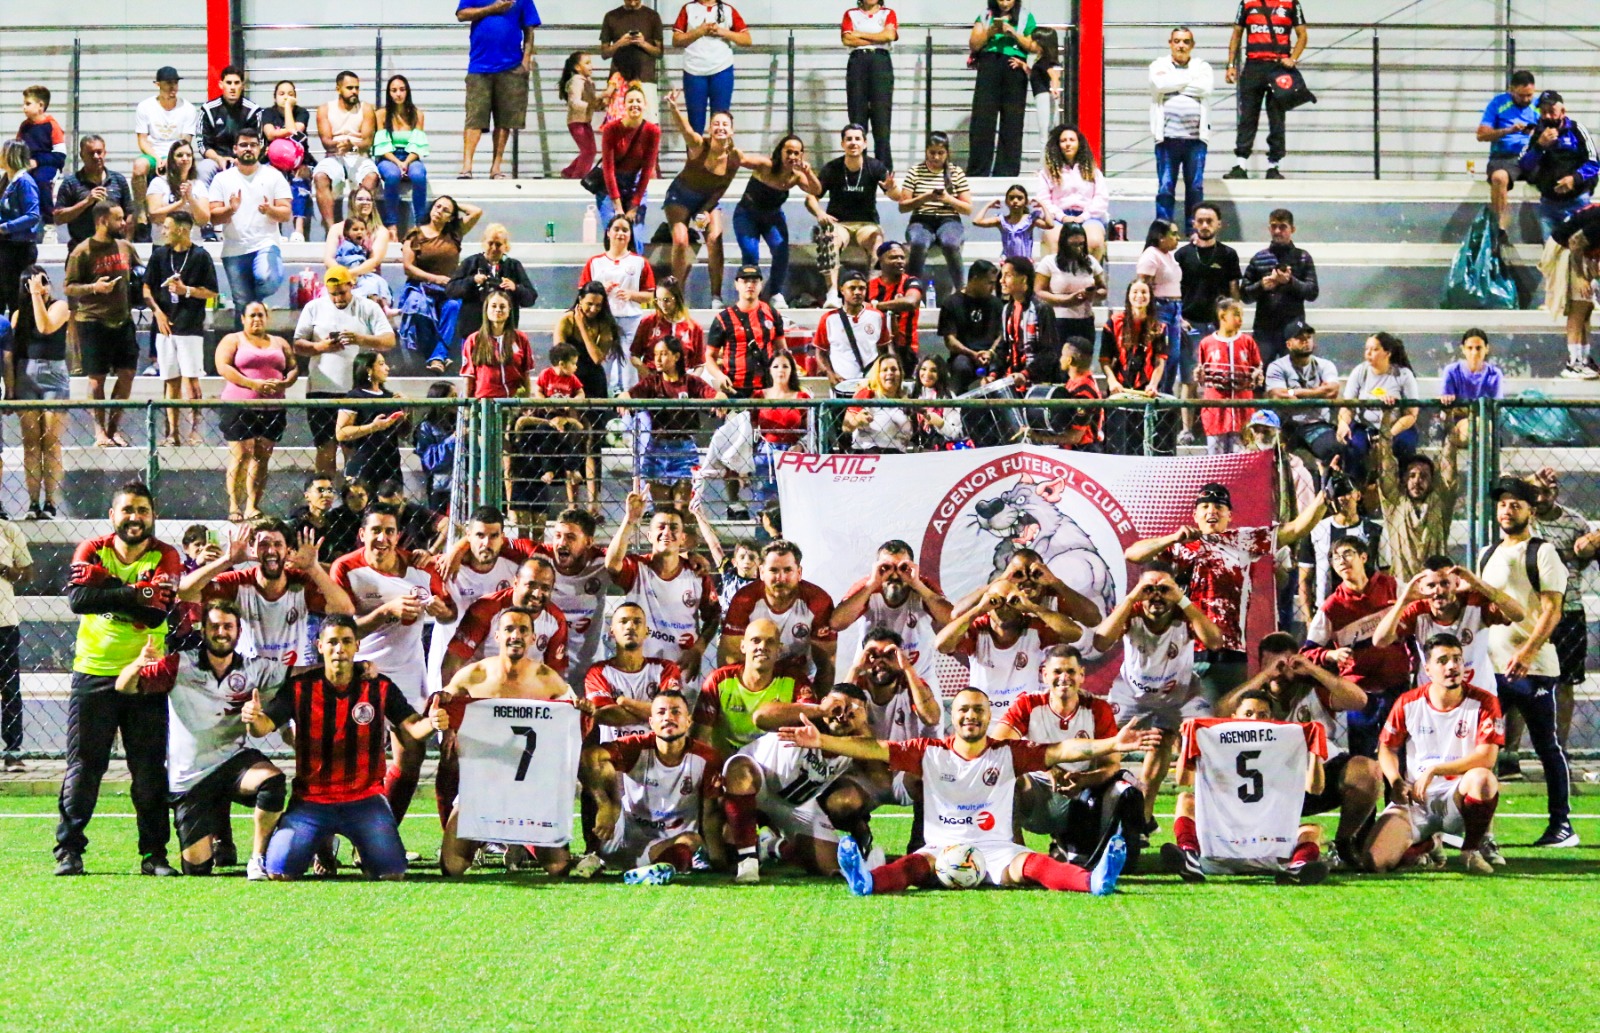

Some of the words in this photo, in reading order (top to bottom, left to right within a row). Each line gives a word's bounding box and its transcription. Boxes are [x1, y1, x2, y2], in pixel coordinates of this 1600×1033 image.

[1250, 24, 1286, 34] Betno
[776, 451, 881, 475] PRATIC
[833, 475, 876, 483] SPORT
[932, 466, 998, 535] AGENOR
[1001, 457, 1077, 485] FUTEBOL
[1080, 480, 1132, 534] CLUBE
[646, 627, 676, 643] FAGOR
[988, 699, 1010, 708] GOR
[493, 705, 533, 719] AGENOR
[535, 706, 553, 720] F.C.
[1219, 729, 1258, 744] AGENOR
[1259, 728, 1277, 742] F.C.
[510, 725, 537, 782] 7
[1235, 749, 1264, 804] 5
[938, 814, 974, 825] FAGOR
